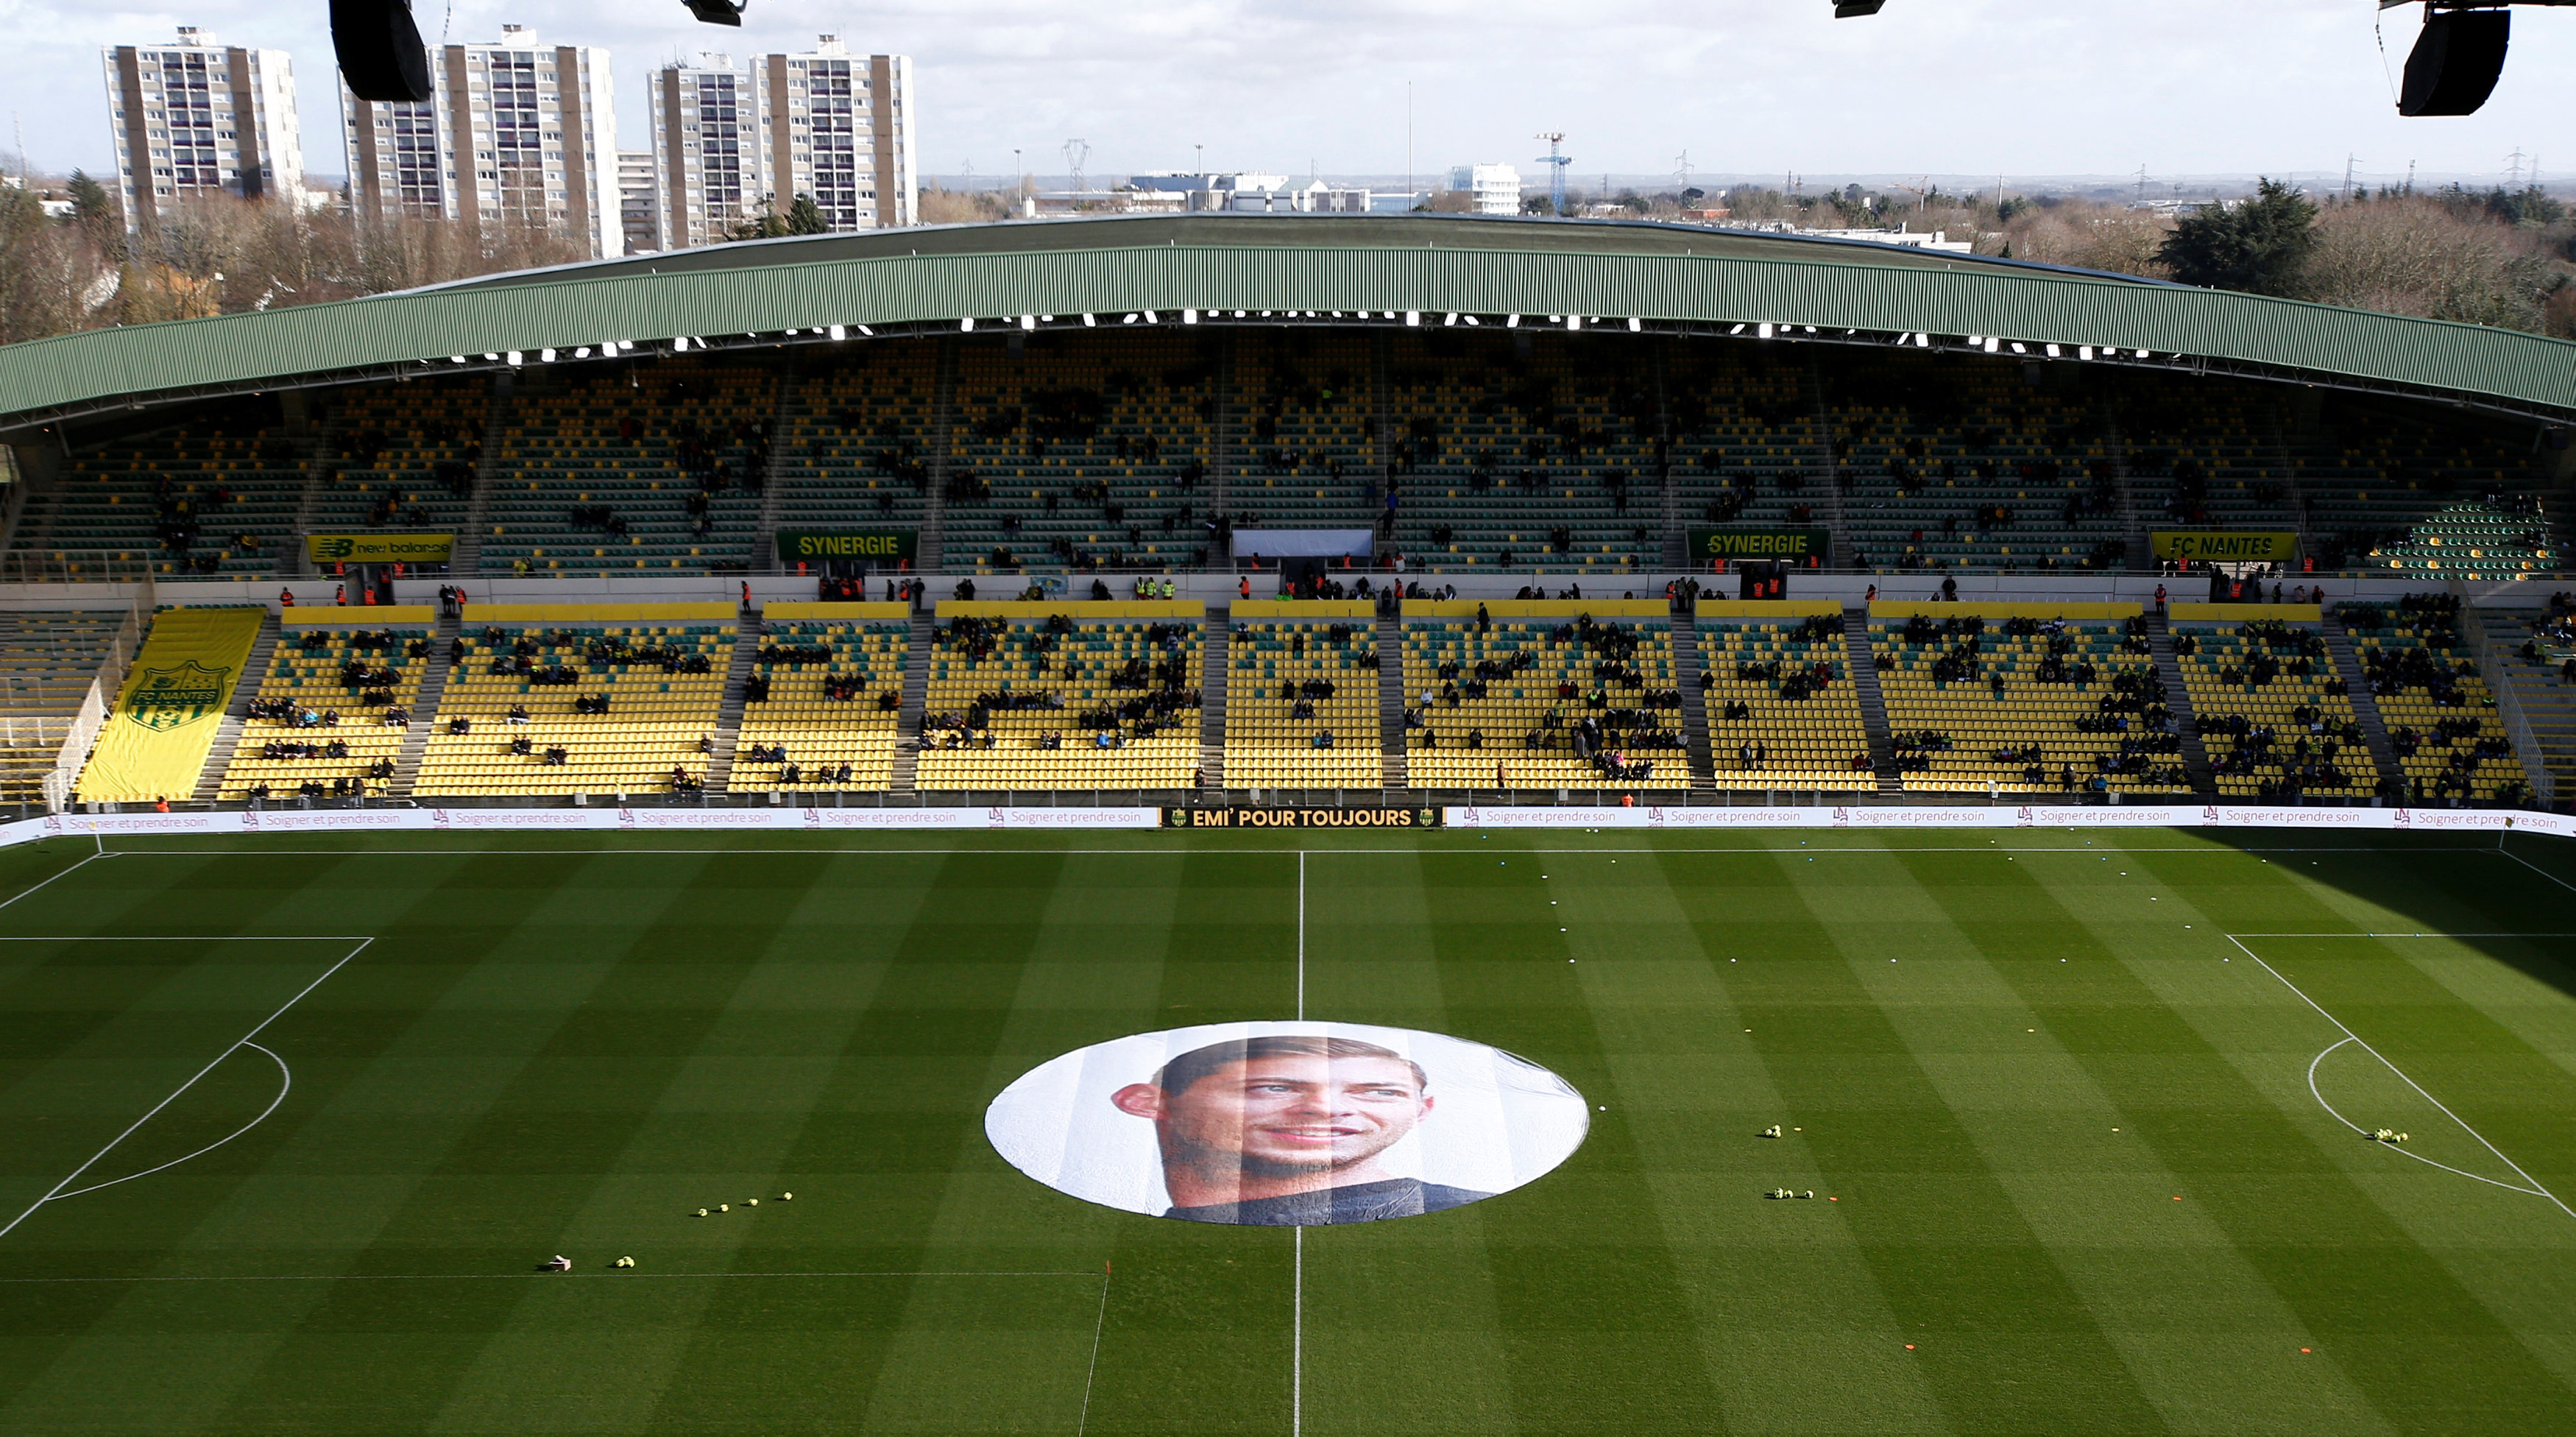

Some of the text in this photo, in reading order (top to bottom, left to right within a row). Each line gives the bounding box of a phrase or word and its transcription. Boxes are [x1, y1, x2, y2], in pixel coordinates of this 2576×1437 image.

[357, 544, 386, 554] new
[389, 542, 450, 554] balance
[799, 536, 898, 554] SYNERGIE
[1708, 535, 1807, 553] SYNERGIE
[2172, 537, 2273, 554] FC NANTES
[138, 691, 216, 700] FC NANTES
[118, 819, 131, 828] et
[133, 817, 181, 830] prendre
[184, 817, 208, 827] soin
[266, 813, 400, 828] Soigner et prendre soin
[456, 813, 586, 826] Soigner et prendre soin
[642, 813, 771, 826] Soigner et prendre soin
[827, 812, 955, 825] Soigner et prendre soin
[1012, 811, 1054, 825] Soigner
[1057, 813, 1067, 822] et
[1071, 812, 1115, 825] prendre
[1118, 812, 1140, 822] soin
[1239, 810, 1296, 827] POUR
[1300, 810, 1412, 827] TOUJOURS
[1487, 811, 1615, 825] Soigner et prendre soin
[1671, 811, 1800, 825] Soigner et prendre soin
[1856, 811, 1984, 824] Soigner et prendre soin
[2041, 811, 2169, 824] Soigner et prendre soin
[2226, 810, 2359, 824] Soigner et prendre soin
[2418, 813, 2463, 827] Soigner
[2466, 814, 2478, 825] et
[2532, 818, 2557, 827] soin
